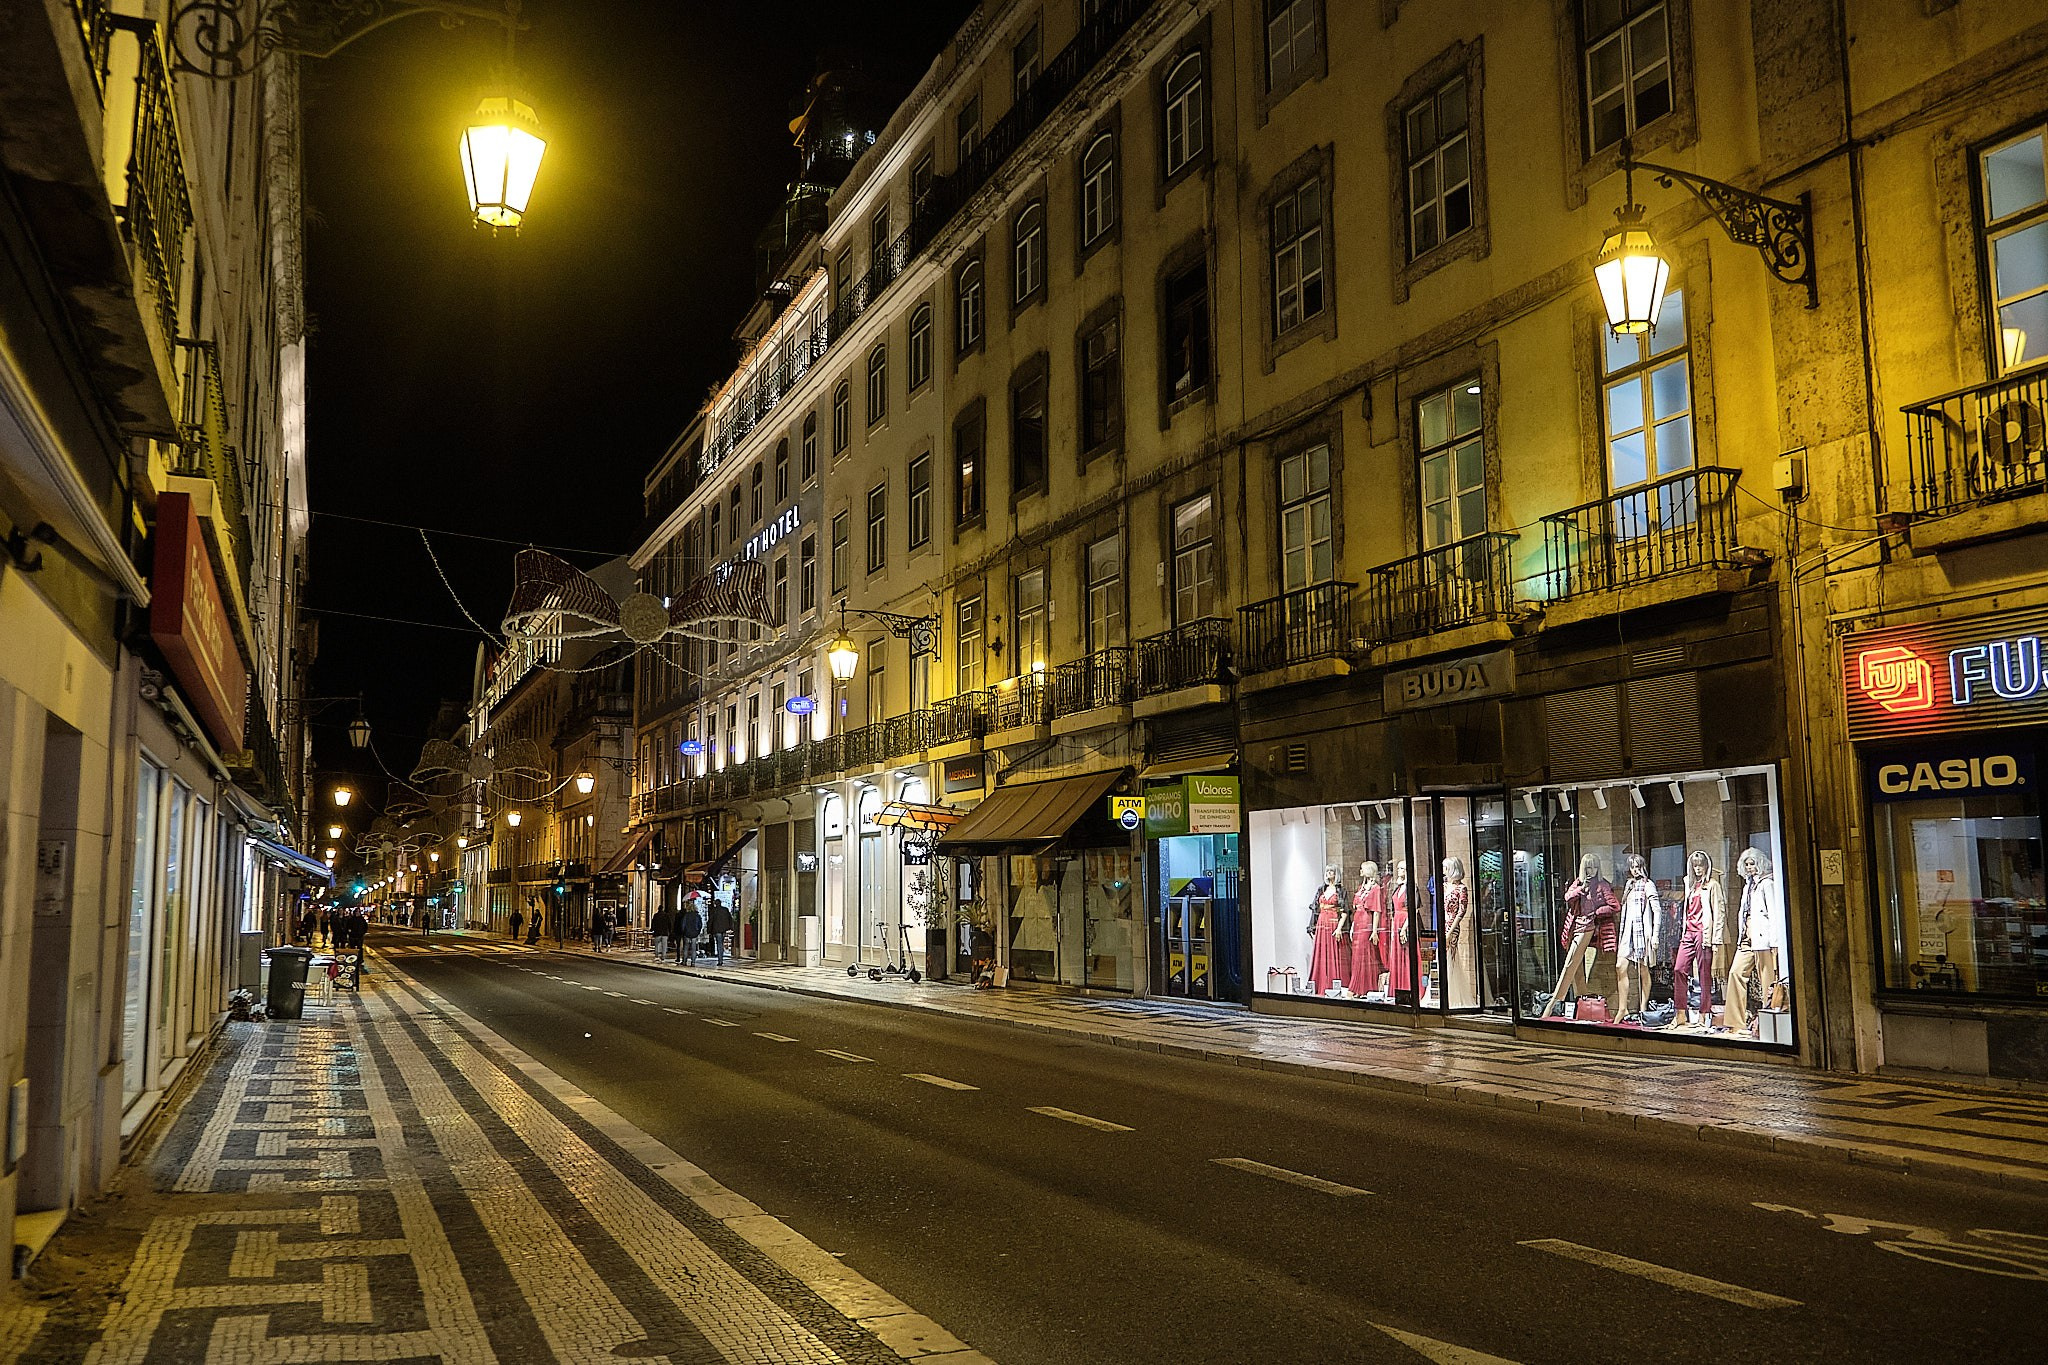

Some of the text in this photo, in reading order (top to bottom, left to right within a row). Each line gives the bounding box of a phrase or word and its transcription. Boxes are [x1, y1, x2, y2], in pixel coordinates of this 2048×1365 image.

[762, 505, 800, 552] HOTEL
[1948, 636, 2048, 705] FU
[1403, 664, 1487, 701] BUDA
[948, 767, 977, 782] MERRELL
[1878, 755, 2018, 794] CASIO
[1195, 780, 1233, 795] Valores
[1117, 799, 1142, 808] ATM
[1147, 790, 1182, 802] COMPRAMOS
[1148, 801, 1182, 821] OURO
[1920, 940, 1944, 948] DVD
[1172, 959, 1183, 967] ATM
[1195, 963, 1206, 971] ATM
